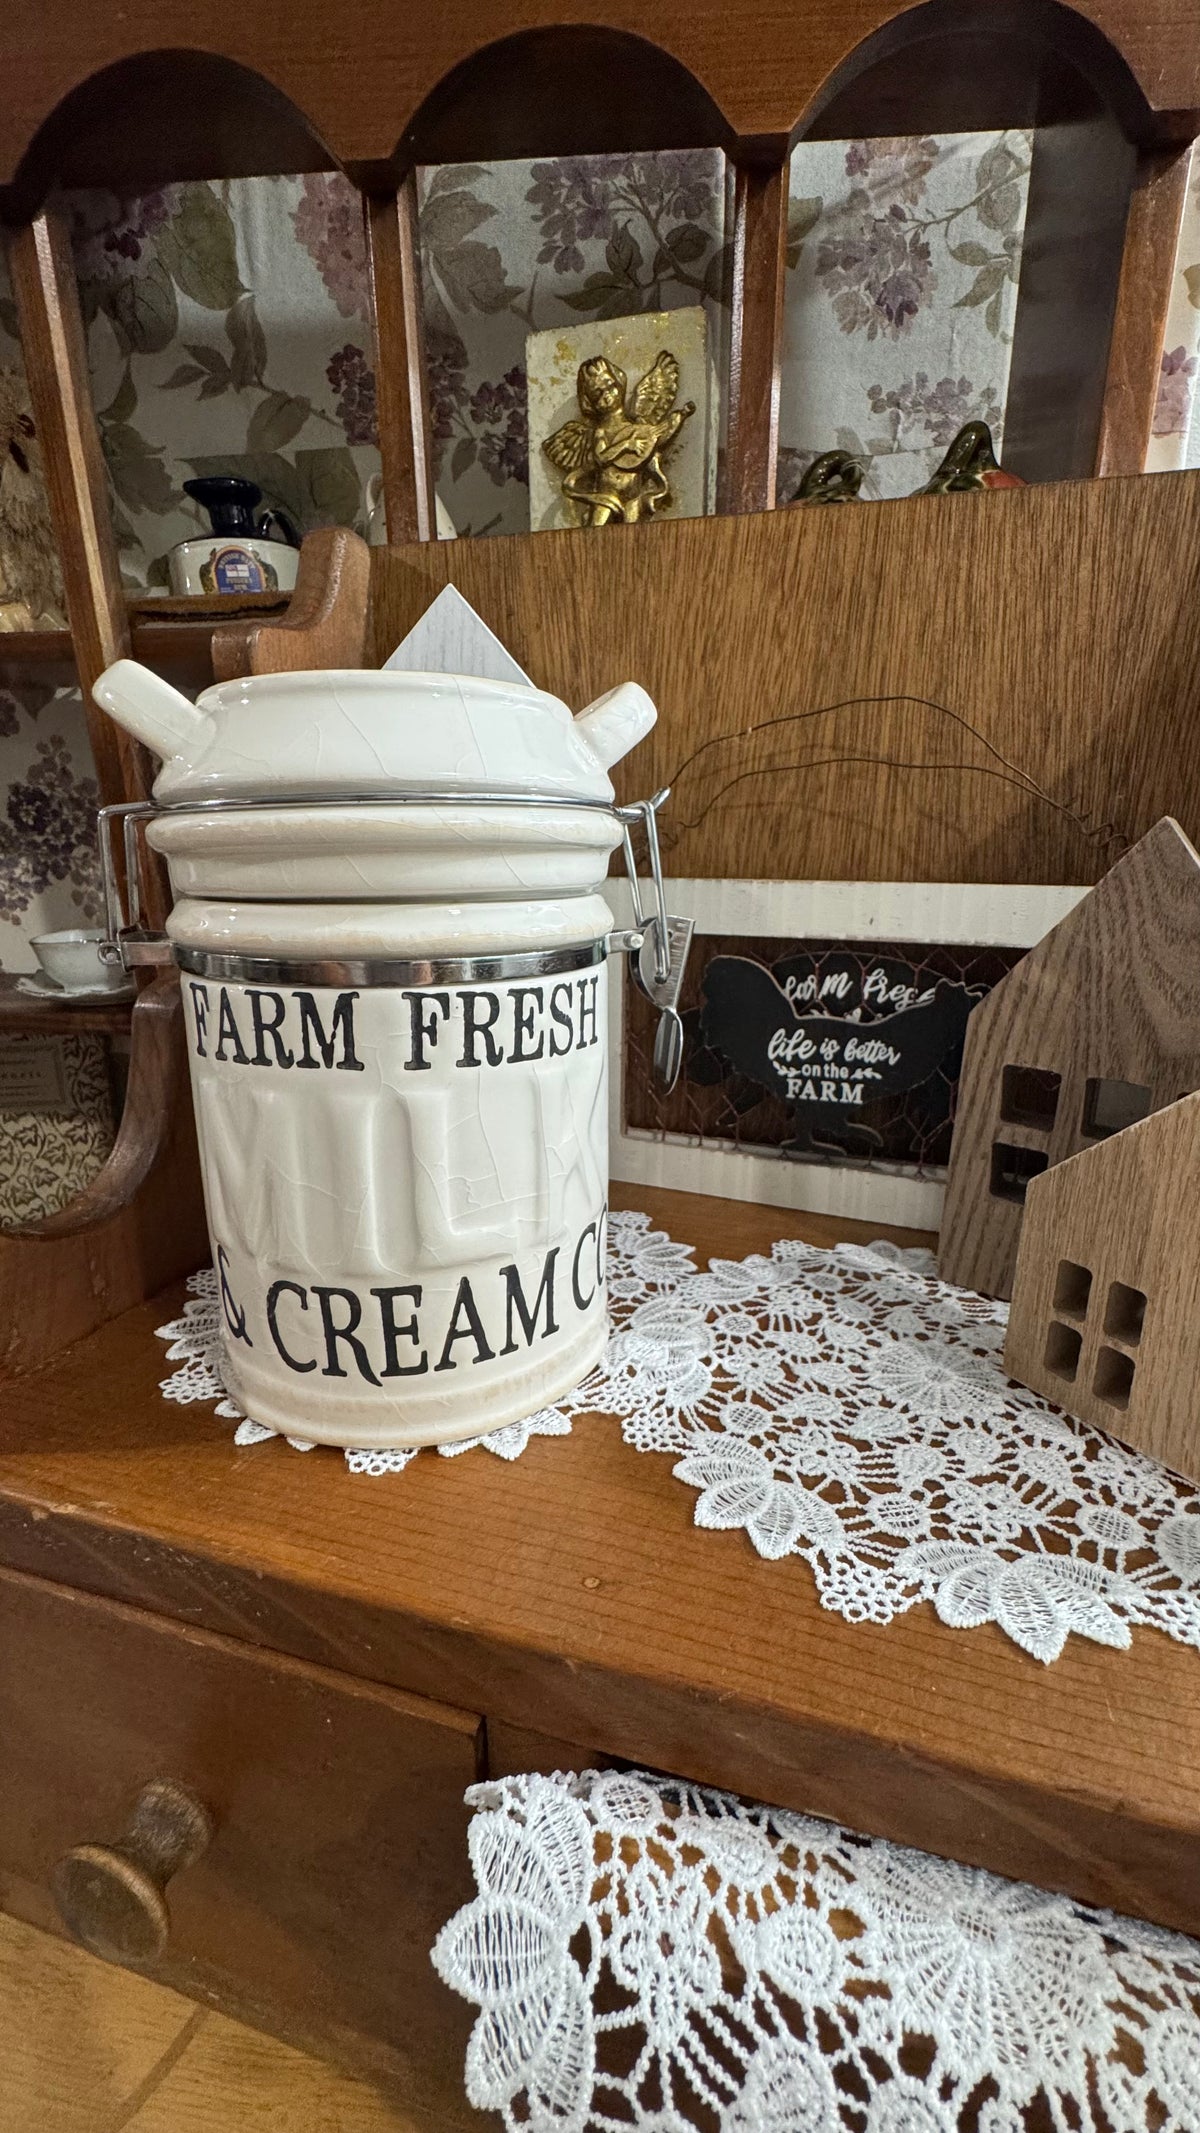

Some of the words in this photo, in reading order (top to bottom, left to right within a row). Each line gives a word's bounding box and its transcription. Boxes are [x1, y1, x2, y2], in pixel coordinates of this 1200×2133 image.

[189, 982, 365, 1071] FARM
[402, 975, 599, 1071] FRESH
[768, 1028, 817, 1062] life
[820, 1037, 841, 1061] is
[844, 1037, 901, 1065] better
[802, 1063, 821, 1077] on
[823, 1062, 849, 1079] the
[785, 1078, 864, 1105] FARM
[266, 1247, 560, 1387] CREAM
